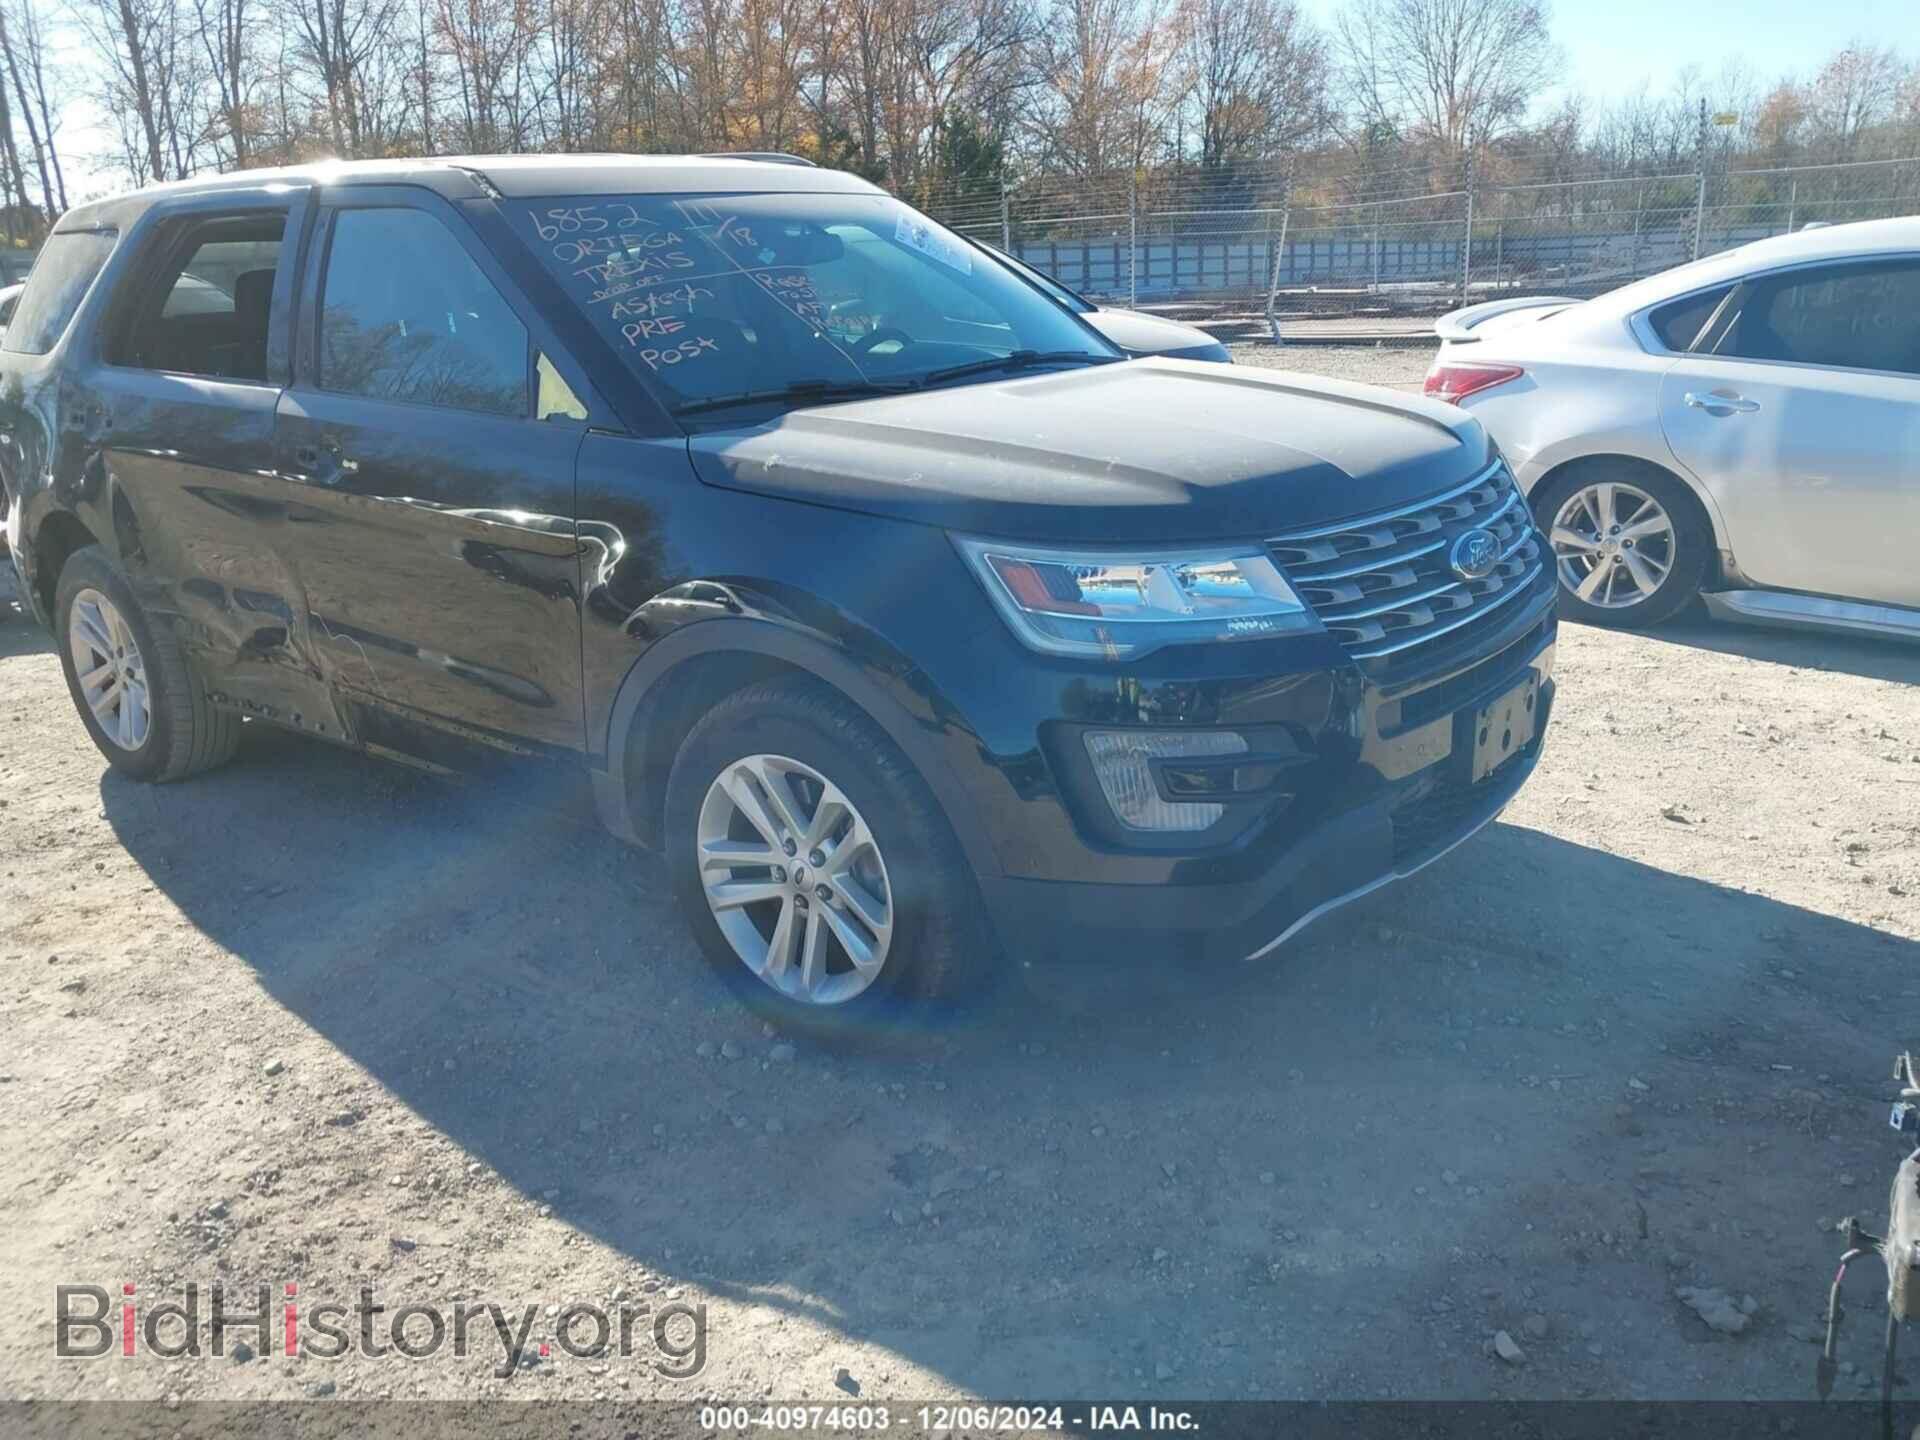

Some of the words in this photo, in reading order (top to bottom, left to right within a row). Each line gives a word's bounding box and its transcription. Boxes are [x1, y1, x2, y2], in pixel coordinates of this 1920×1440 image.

[528, 204, 661, 241] 6852
[552, 231, 683, 264] ORTEGA
[621, 315, 687, 346] PRE
